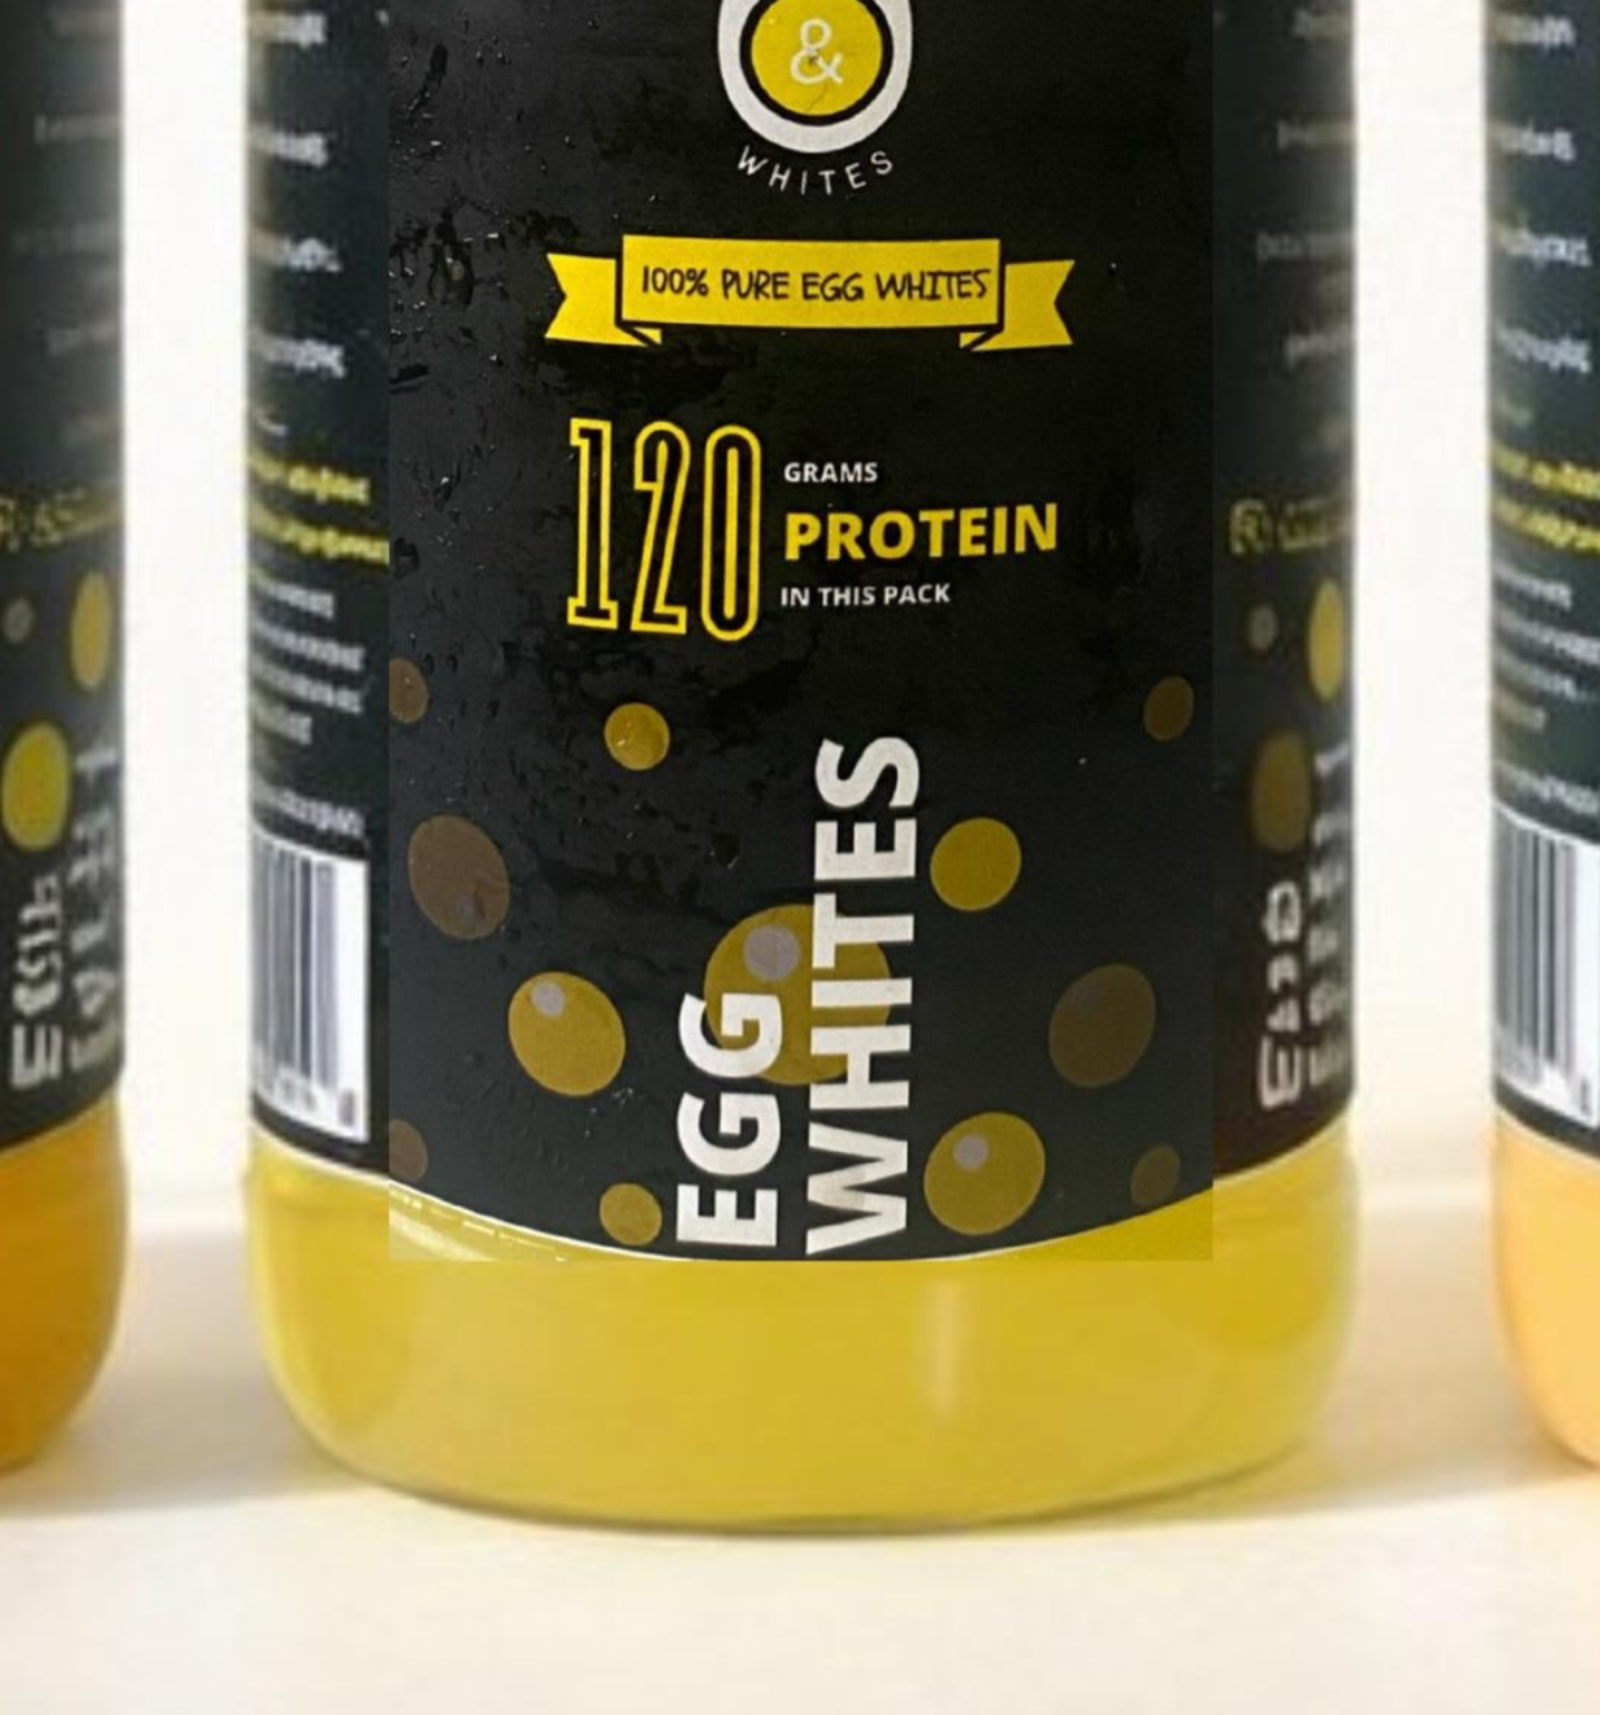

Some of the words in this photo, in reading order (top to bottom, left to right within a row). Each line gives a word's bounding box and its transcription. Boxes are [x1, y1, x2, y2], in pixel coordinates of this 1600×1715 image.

[790, 17, 845, 86] &
[735, 144, 896, 197] WHITES
[641, 265, 710, 298] 100%
[720, 267, 791, 302] PURE
[800, 270, 866, 304] EGG
[873, 267, 992, 303] WHITES
[782, 460, 879, 484] GRAMS
[564, 415, 764, 644] 120
[783, 501, 1059, 563] PROTEIN
[779, 585, 811, 608] IN
[817, 585, 877, 608] THIS
[882, 582, 951, 606] PACK
[804, 732, 922, 1257] WHITES
[675, 991, 785, 1251] EGG
